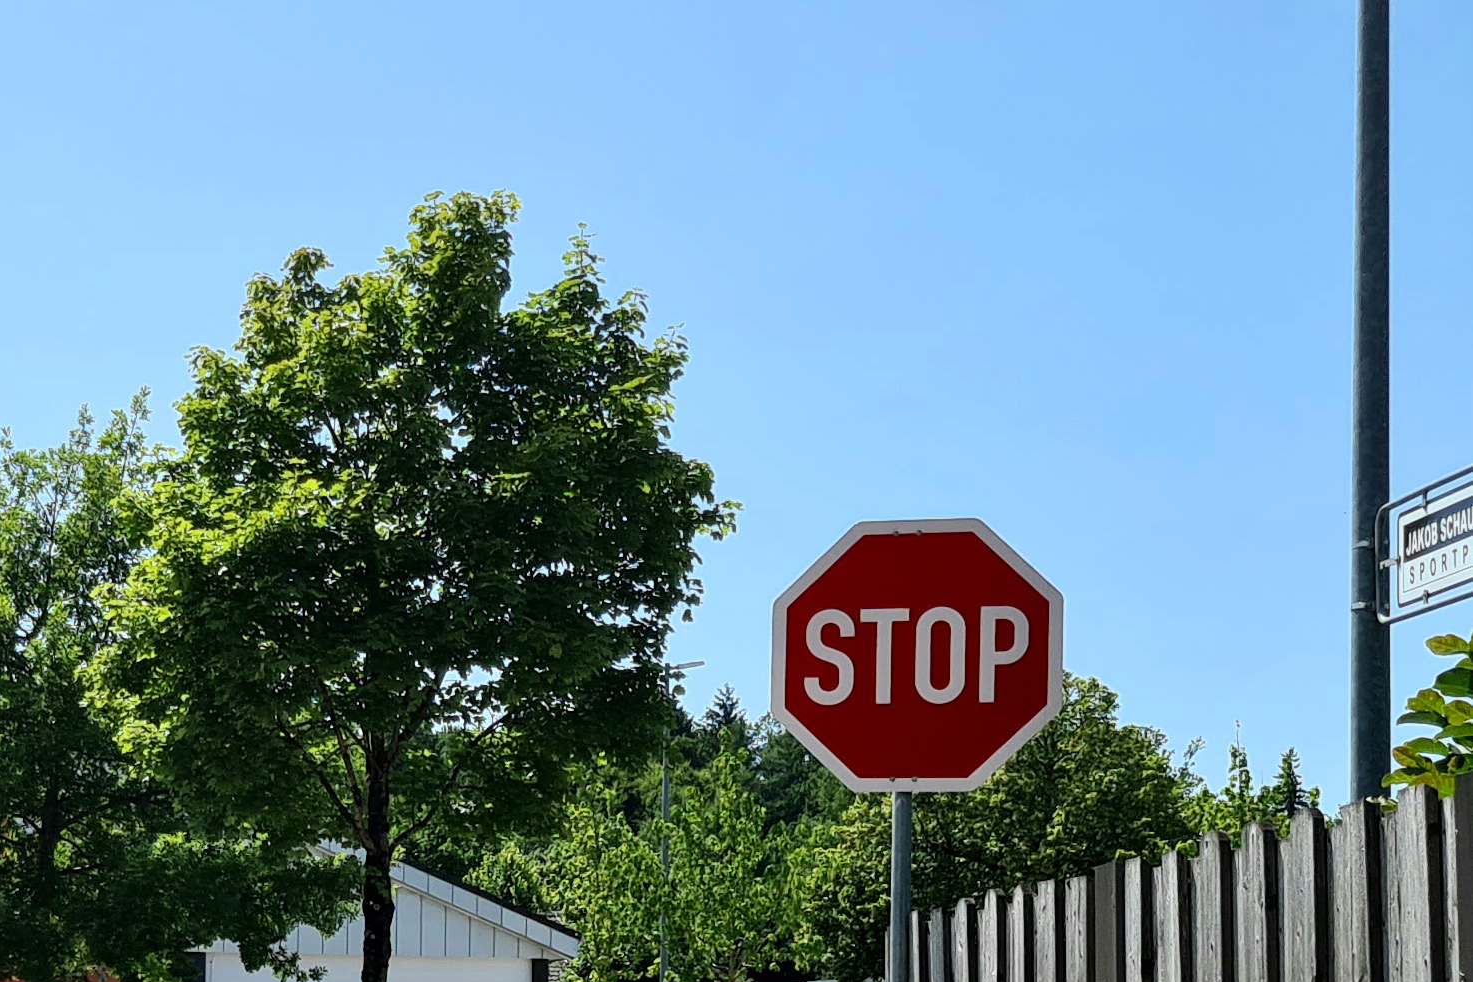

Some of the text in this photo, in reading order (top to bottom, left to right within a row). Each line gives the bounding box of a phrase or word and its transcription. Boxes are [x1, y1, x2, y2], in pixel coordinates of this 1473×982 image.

[1405, 521, 1438, 557] JAKOB
[1409, 544, 1469, 585] SPORTP
[803, 605, 1030, 706] STOP
